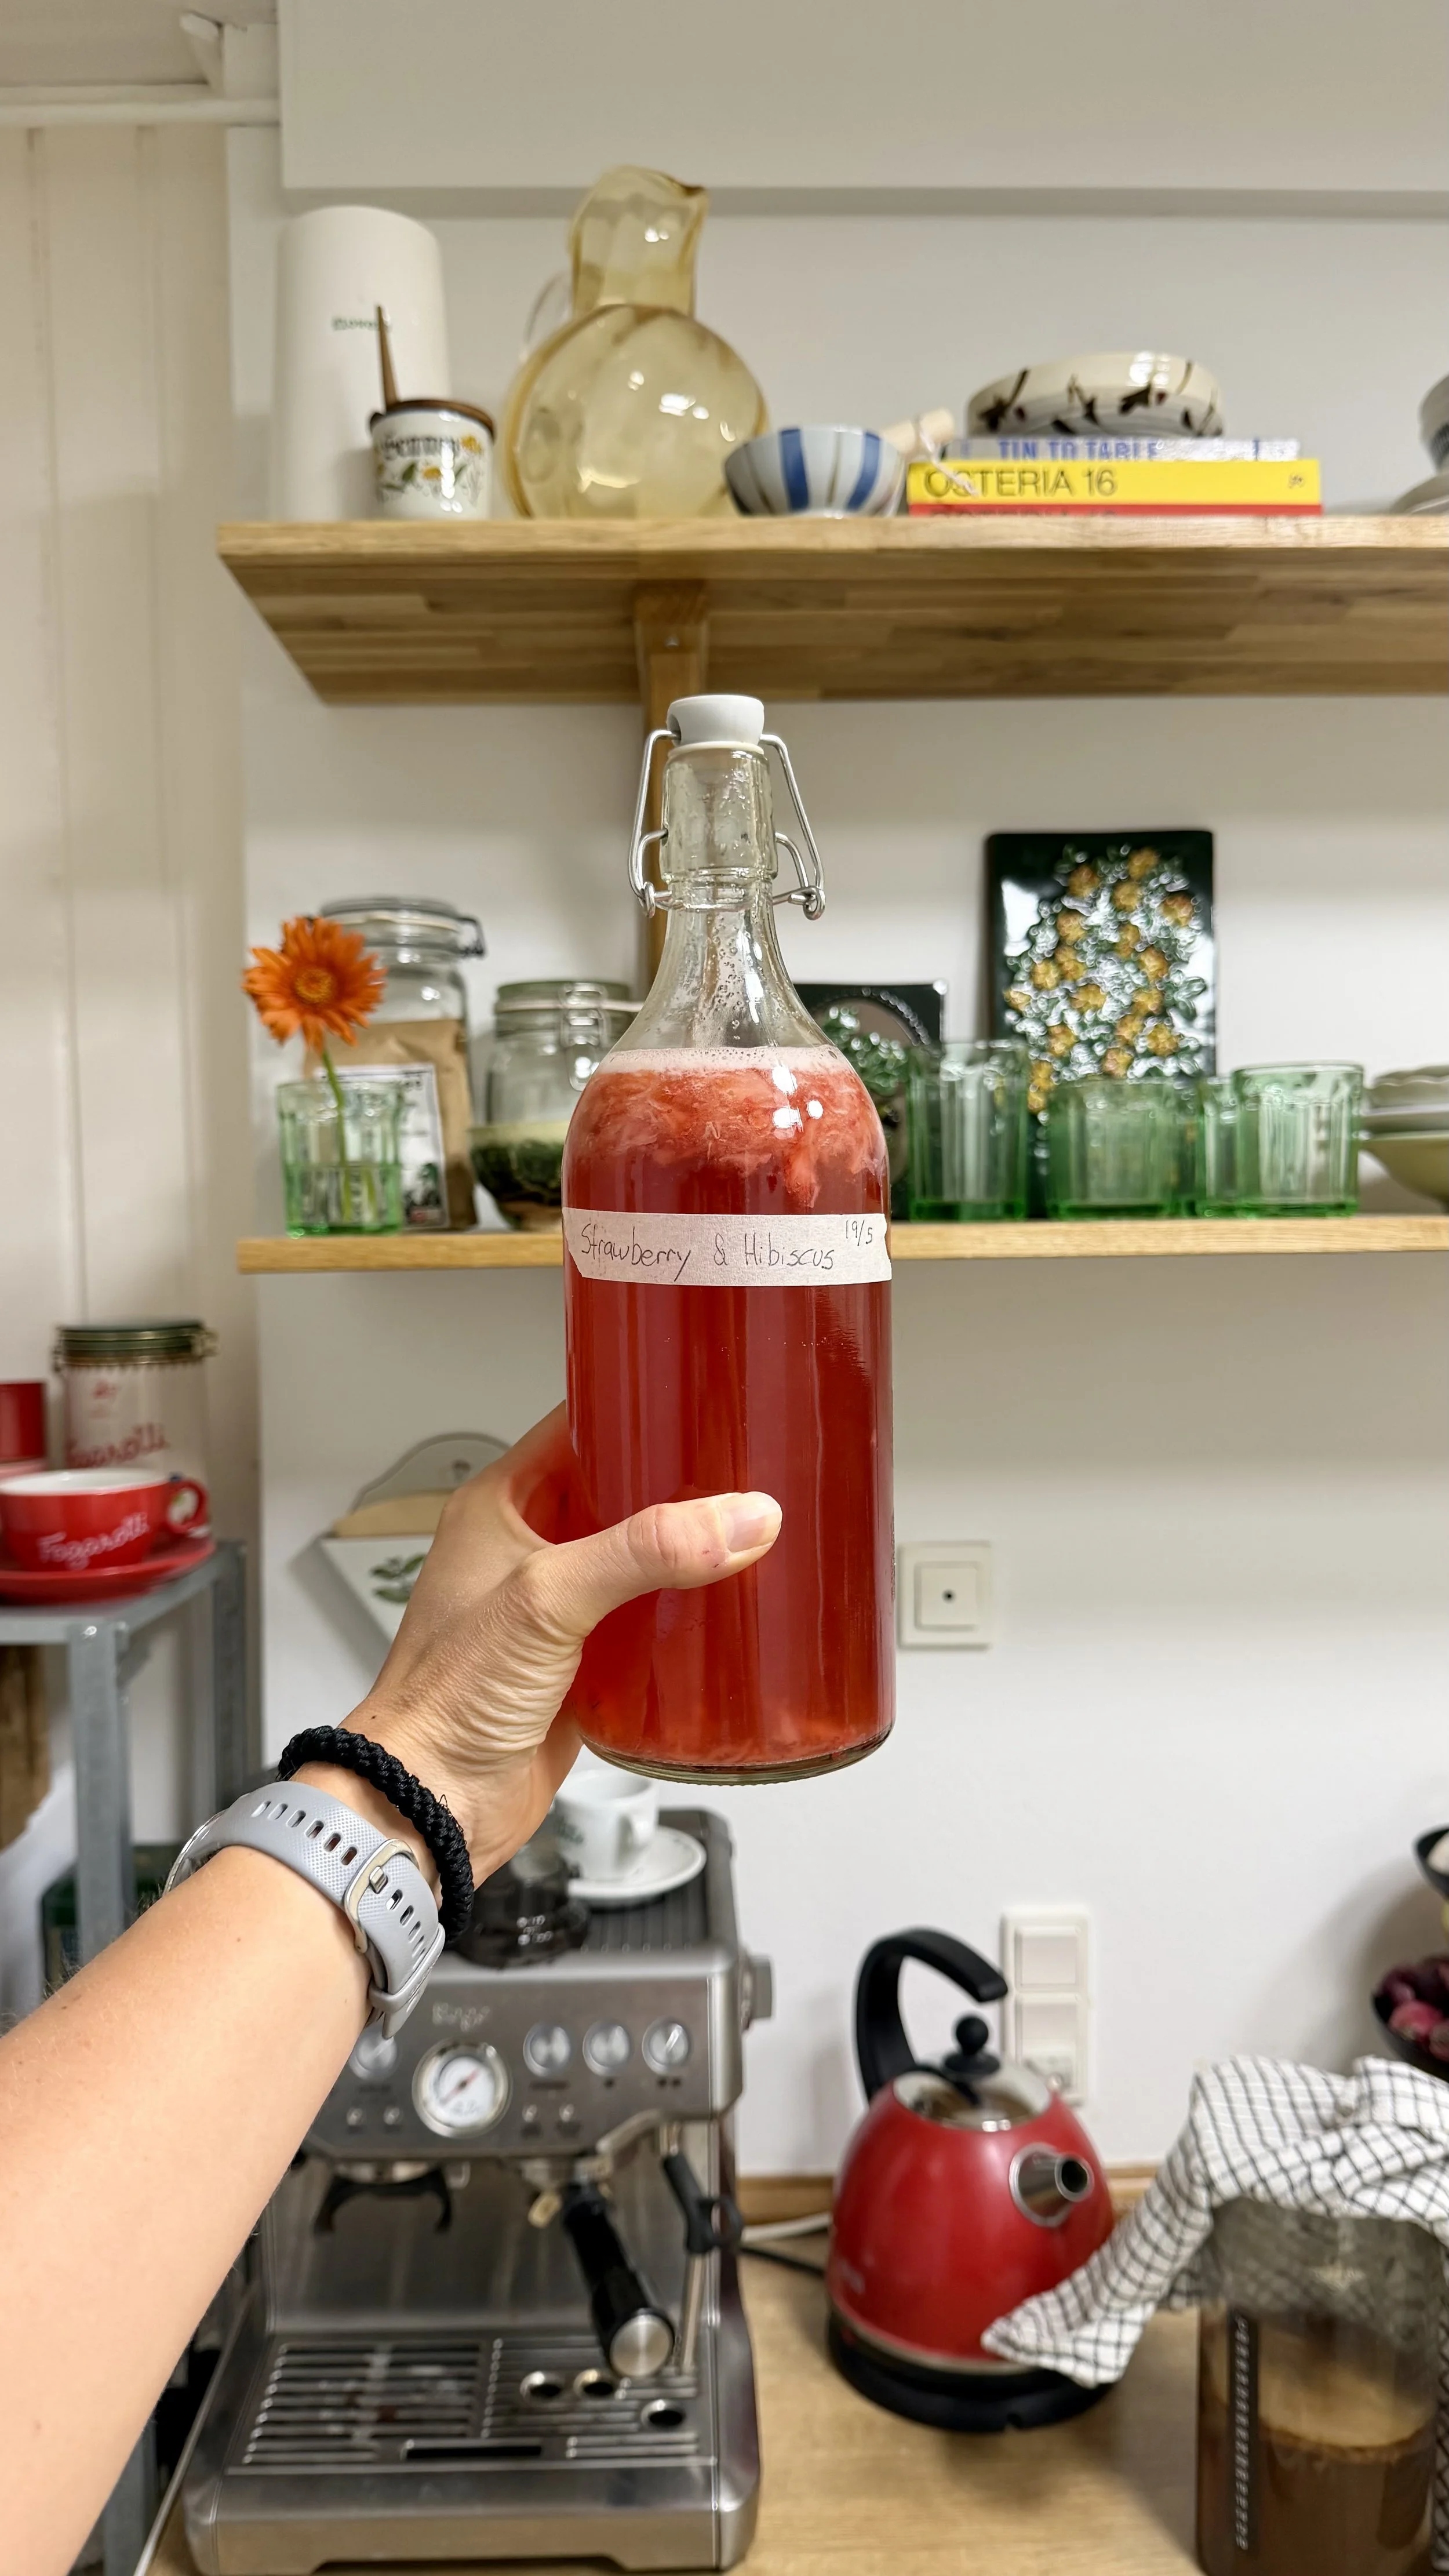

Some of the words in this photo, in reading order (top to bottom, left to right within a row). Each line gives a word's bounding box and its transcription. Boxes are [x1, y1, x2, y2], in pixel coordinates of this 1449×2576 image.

[999, 441, 1037, 460] TIN
[924, 469, 1074, 497] OSTERIA
[1085, 468, 1118, 497] 16
[845, 1219, 873, 1247] 19/5
[581, 1222, 691, 1282] Strawberry
[713, 1232, 728, 1266] &
[744, 1231, 835, 1270] Hibiscus
